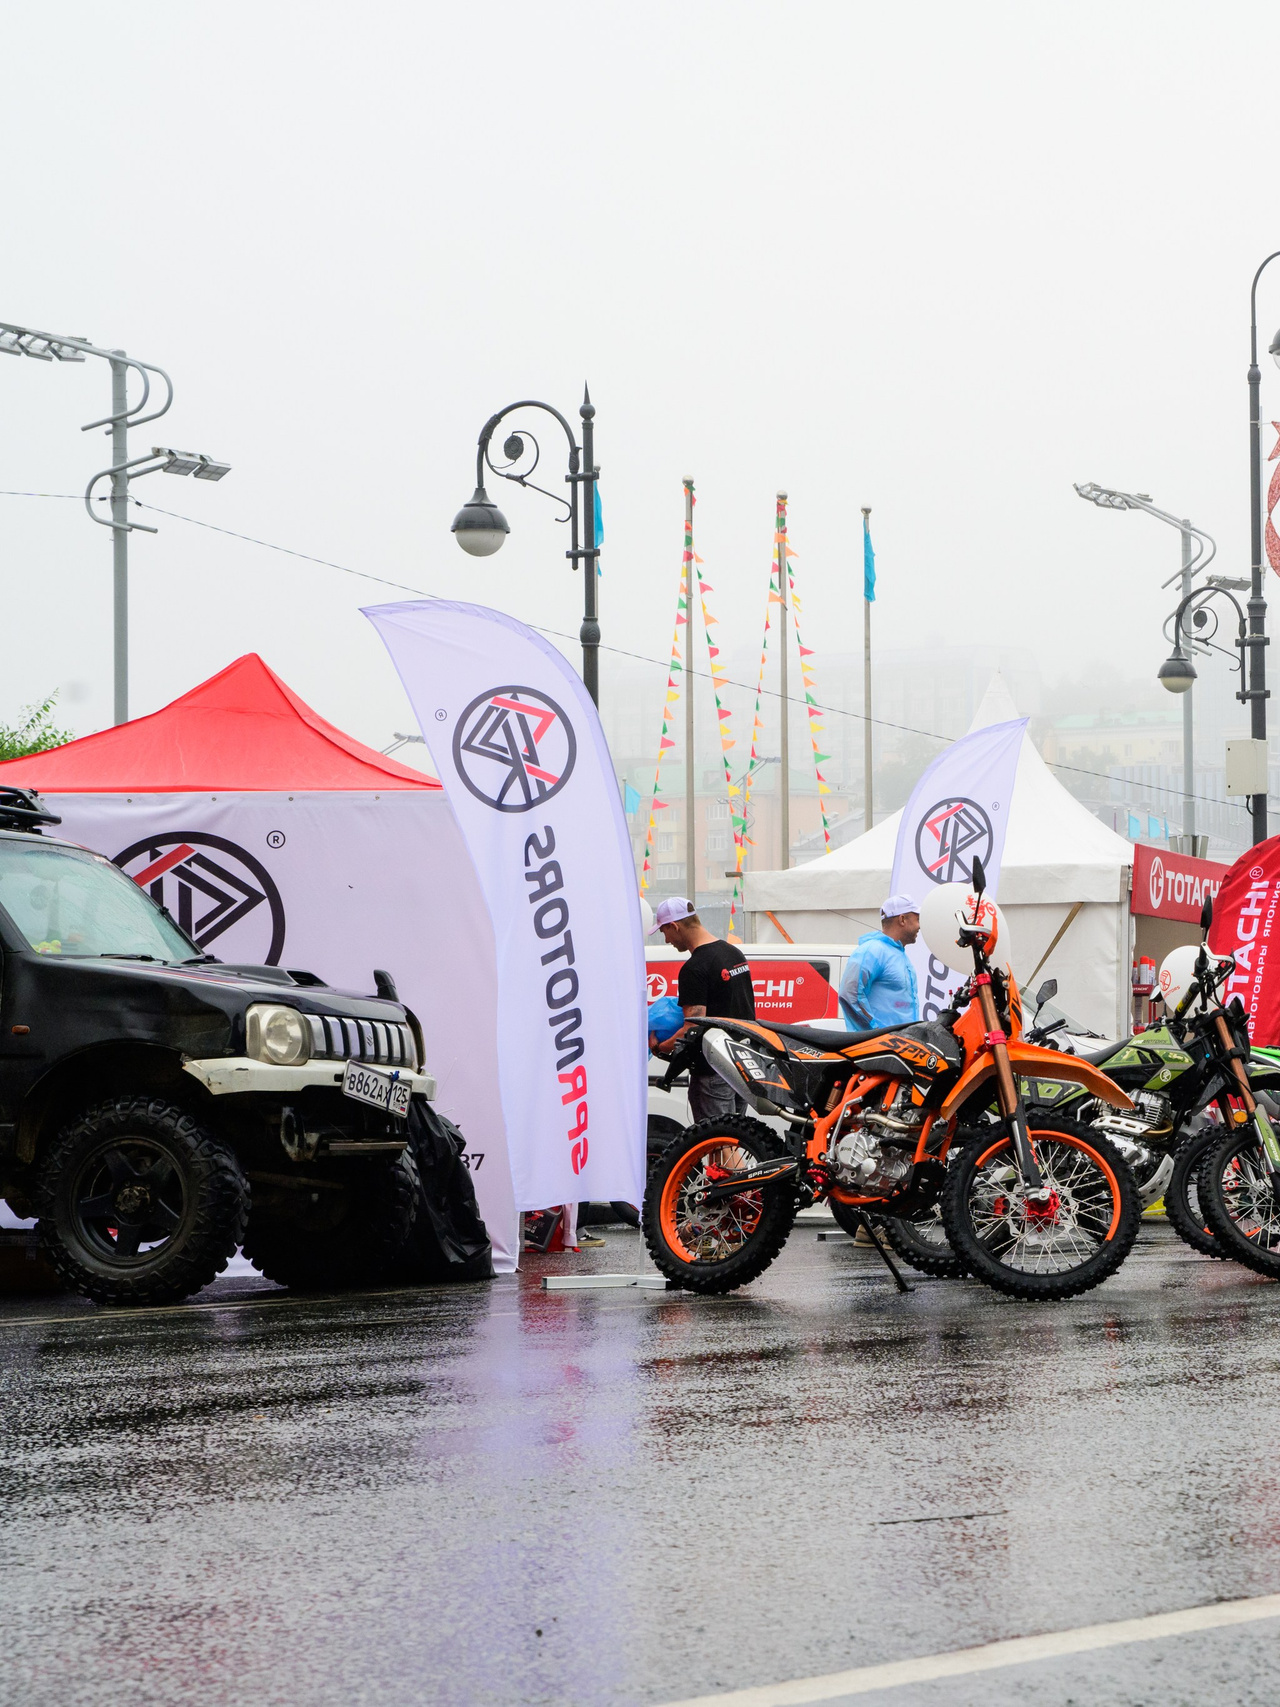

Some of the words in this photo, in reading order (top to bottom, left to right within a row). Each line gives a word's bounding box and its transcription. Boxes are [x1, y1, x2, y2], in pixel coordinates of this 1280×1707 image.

[1225, 880, 1270, 1009] OTACHI
[1248, 945, 1268, 1040] АВТОТОВАРЫ
[754, 1001, 793, 1009] ПОНИЯ
[796, 1046, 823, 1059] MAX
[879, 1038, 927, 1061] SPR
[735, 1050, 767, 1080] 300
[392, 1084, 408, 1105] 125
[748, 1170, 763, 1179] SPR
